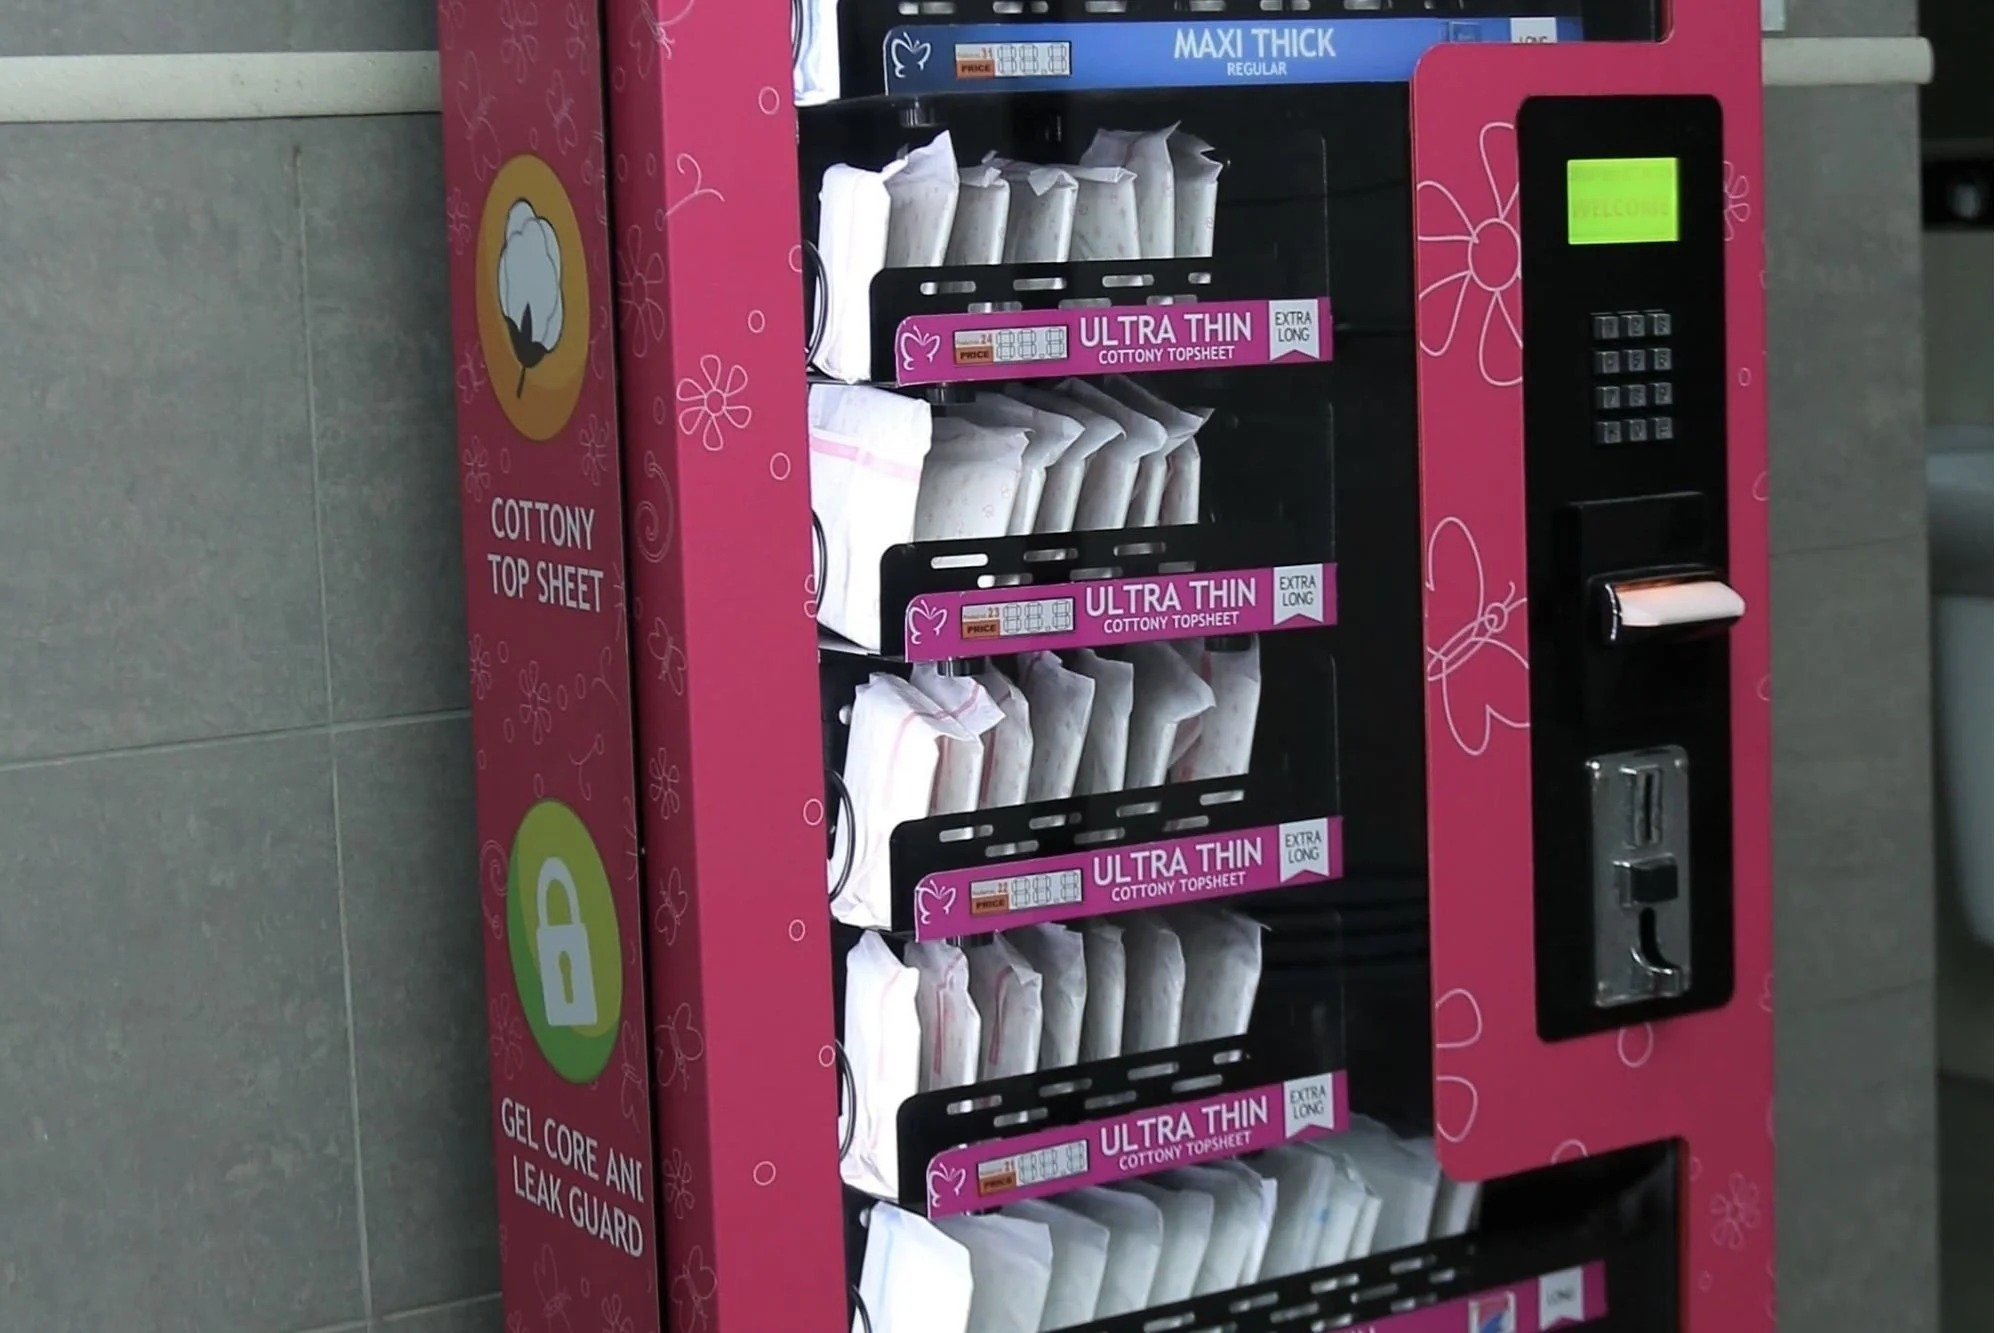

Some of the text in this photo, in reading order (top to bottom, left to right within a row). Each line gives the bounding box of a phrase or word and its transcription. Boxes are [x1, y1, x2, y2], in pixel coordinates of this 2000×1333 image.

[1174, 28, 1336, 58] MAXI THICK
[961, 63, 991, 73] PRICE
[1227, 62, 1287, 76] REGULAR
[1275, 312, 1312, 325] EXTRA
[1080, 312, 1252, 347] ULTRA THIN
[1278, 327, 1310, 342] LONG
[960, 351, 989, 360] PRICE
[1099, 345, 1235, 364] COTTONY TOPSHEET
[491, 496, 595, 550] COTTONY
[487, 553, 604, 613] TOP SHEET
[1279, 576, 1316, 590] EXTRA
[1086, 578, 1256, 616] ULTRA THIN
[1282, 592, 1314, 607] LONG
[988, 607, 999, 618] 23
[967, 624, 996, 634] PRICE
[1104, 611, 1239, 634] COTTONY TOPSHEET
[1285, 830, 1322, 847] EXTRA
[1093, 837, 1262, 886] ULTRA THIN
[1288, 848, 1320, 864] LONG
[1111, 871, 1246, 902] COTTONY TOPSHEET
[1290, 1085, 1327, 1103] EXTRA
[1293, 1101, 1324, 1119] LONG
[1100, 1096, 1268, 1156] ULTRA THIN
[501, 1097, 539, 1150] GEL
[544, 1118, 600, 1181] CORE
[1119, 1131, 1252, 1170] COTTONY TOPSHEET
[513, 1154, 643, 1257] LEAK GUARD
